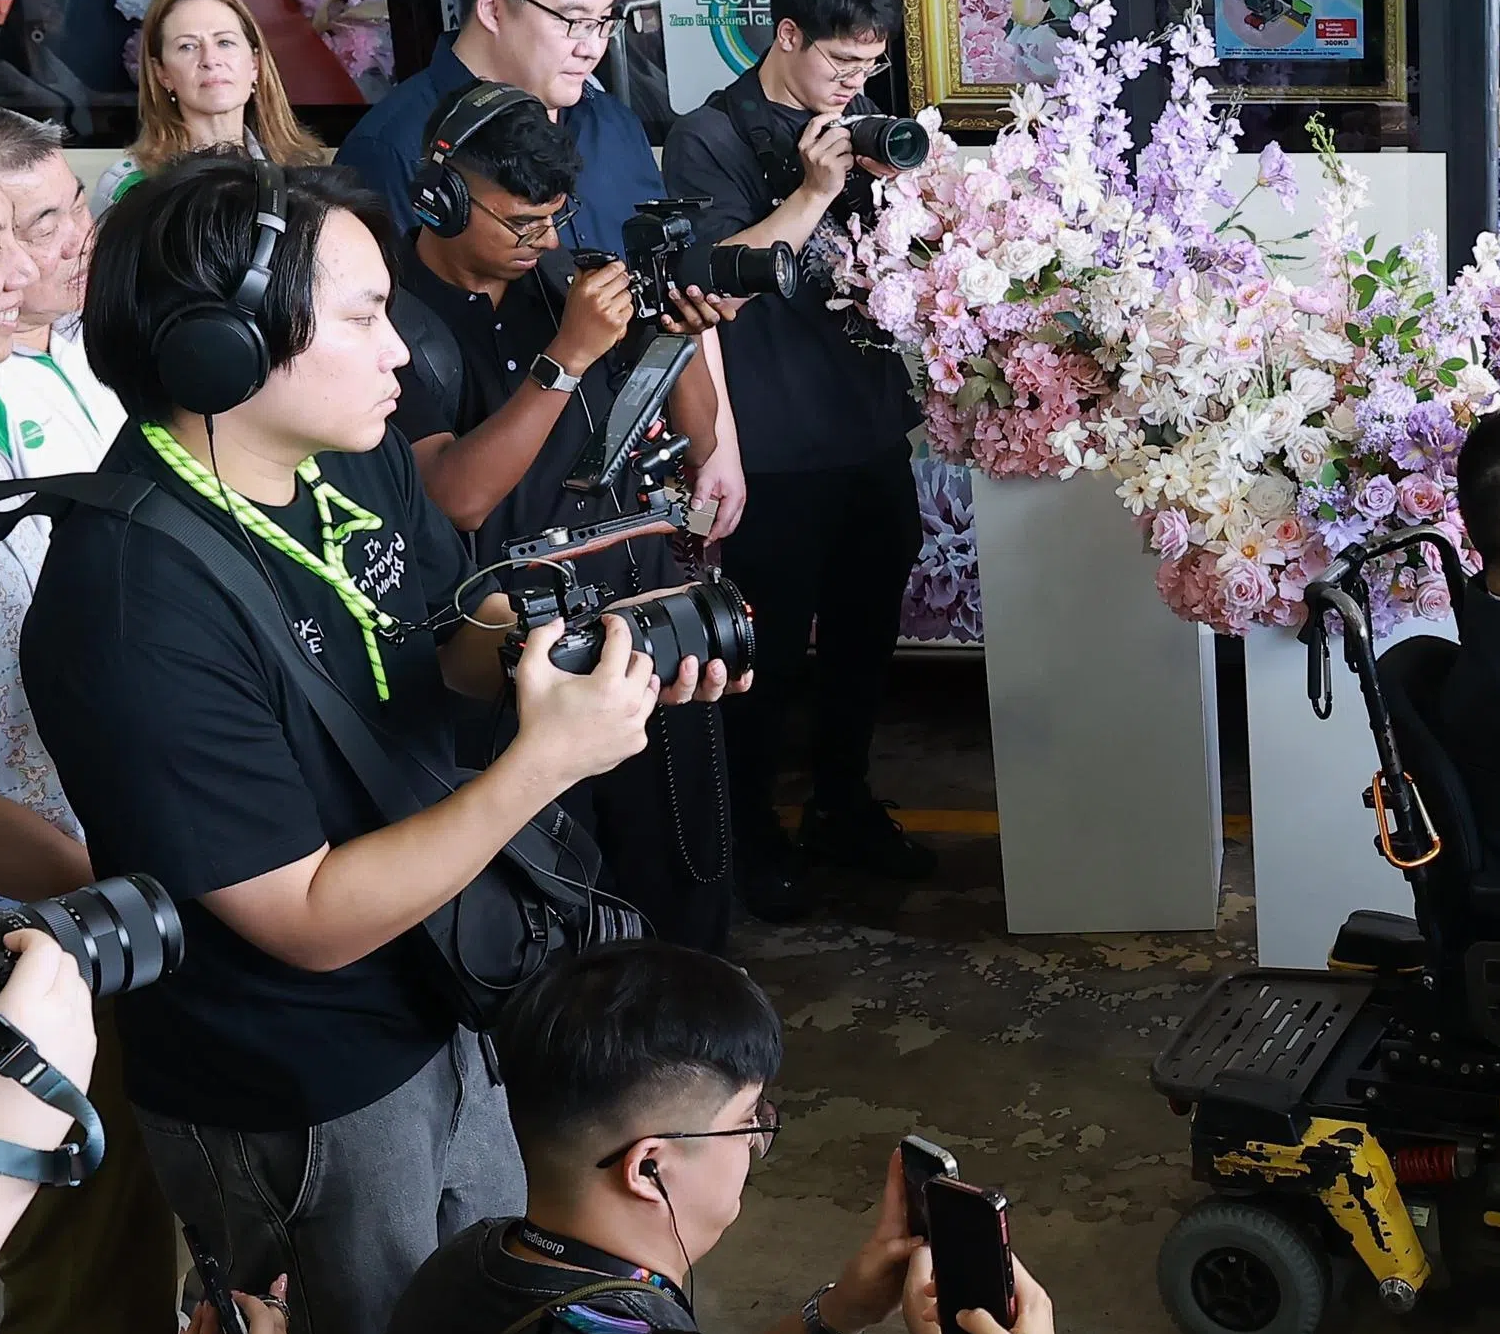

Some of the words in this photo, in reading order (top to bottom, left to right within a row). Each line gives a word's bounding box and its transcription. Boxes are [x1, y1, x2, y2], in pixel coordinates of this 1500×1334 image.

[669, 14, 694, 27] Zero
[696, 14, 747, 27] Emissions
[523, 1229, 566, 1256] mediacorp
